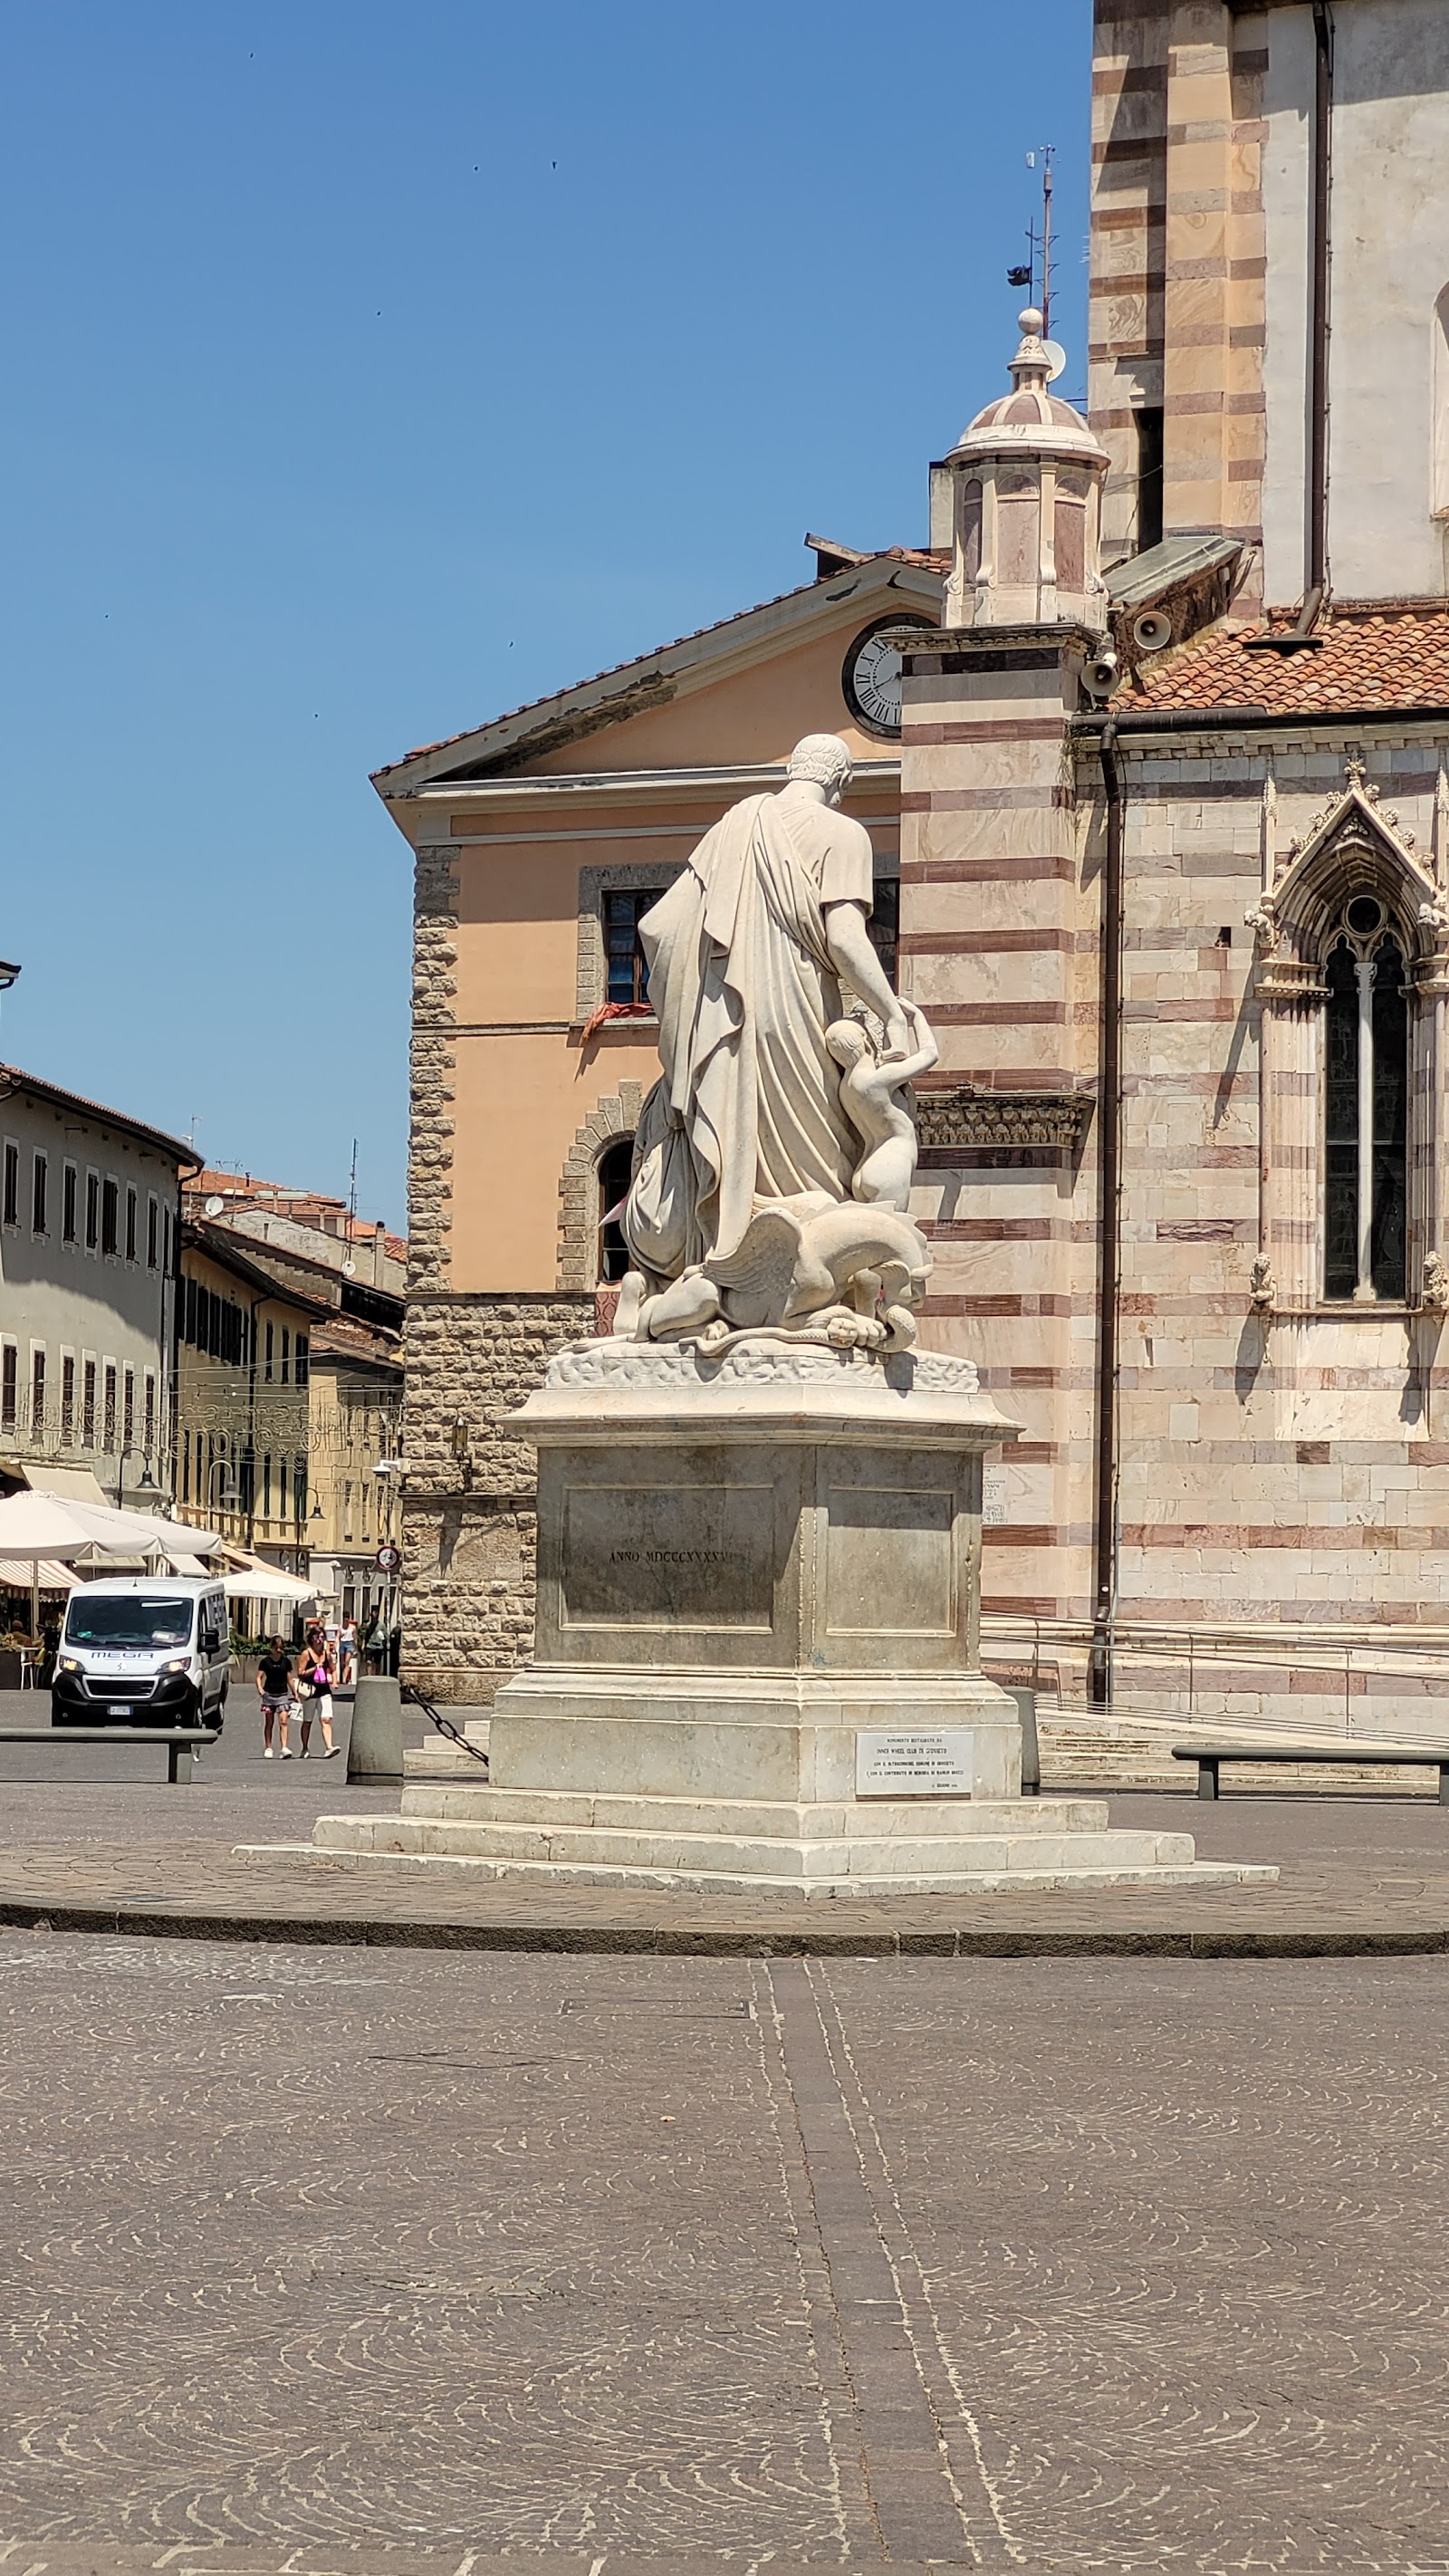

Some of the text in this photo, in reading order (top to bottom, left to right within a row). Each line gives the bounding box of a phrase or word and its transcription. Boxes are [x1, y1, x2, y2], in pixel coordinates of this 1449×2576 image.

[860, 652, 875, 666] X
[856, 672, 870, 684] IX
[609, 1551, 639, 1563] ANNO
